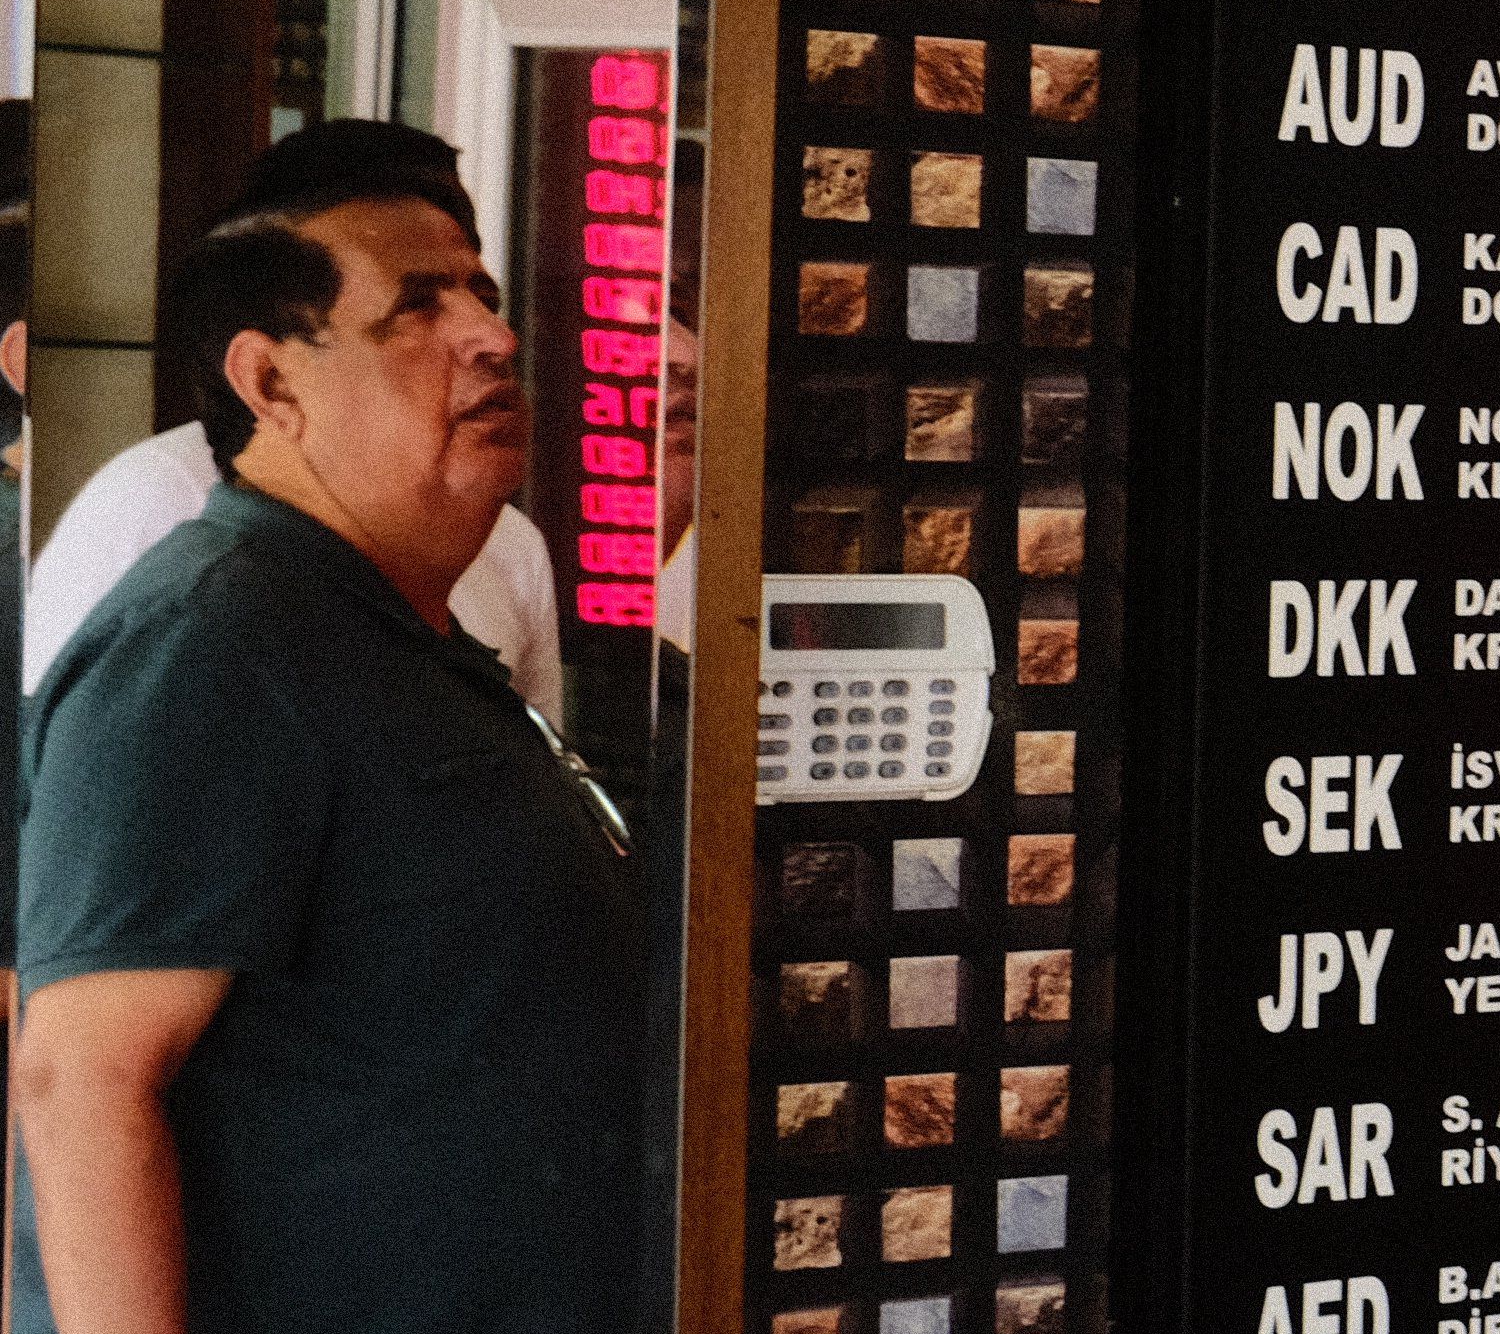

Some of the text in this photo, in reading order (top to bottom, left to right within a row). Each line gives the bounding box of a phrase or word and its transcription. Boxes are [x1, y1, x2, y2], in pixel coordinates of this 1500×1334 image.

[1278, 44, 1424, 147] AUD
[1277, 222, 1418, 324] CAD
[1273, 401, 1425, 501] NOK
[1268, 579, 1417, 677] DKK
[1263, 754, 1403, 856] SEK
[1257, 928, 1393, 1033] JPY
[1255, 1102, 1394, 1209] SAR
[1442, 1095, 1482, 1132] S.
